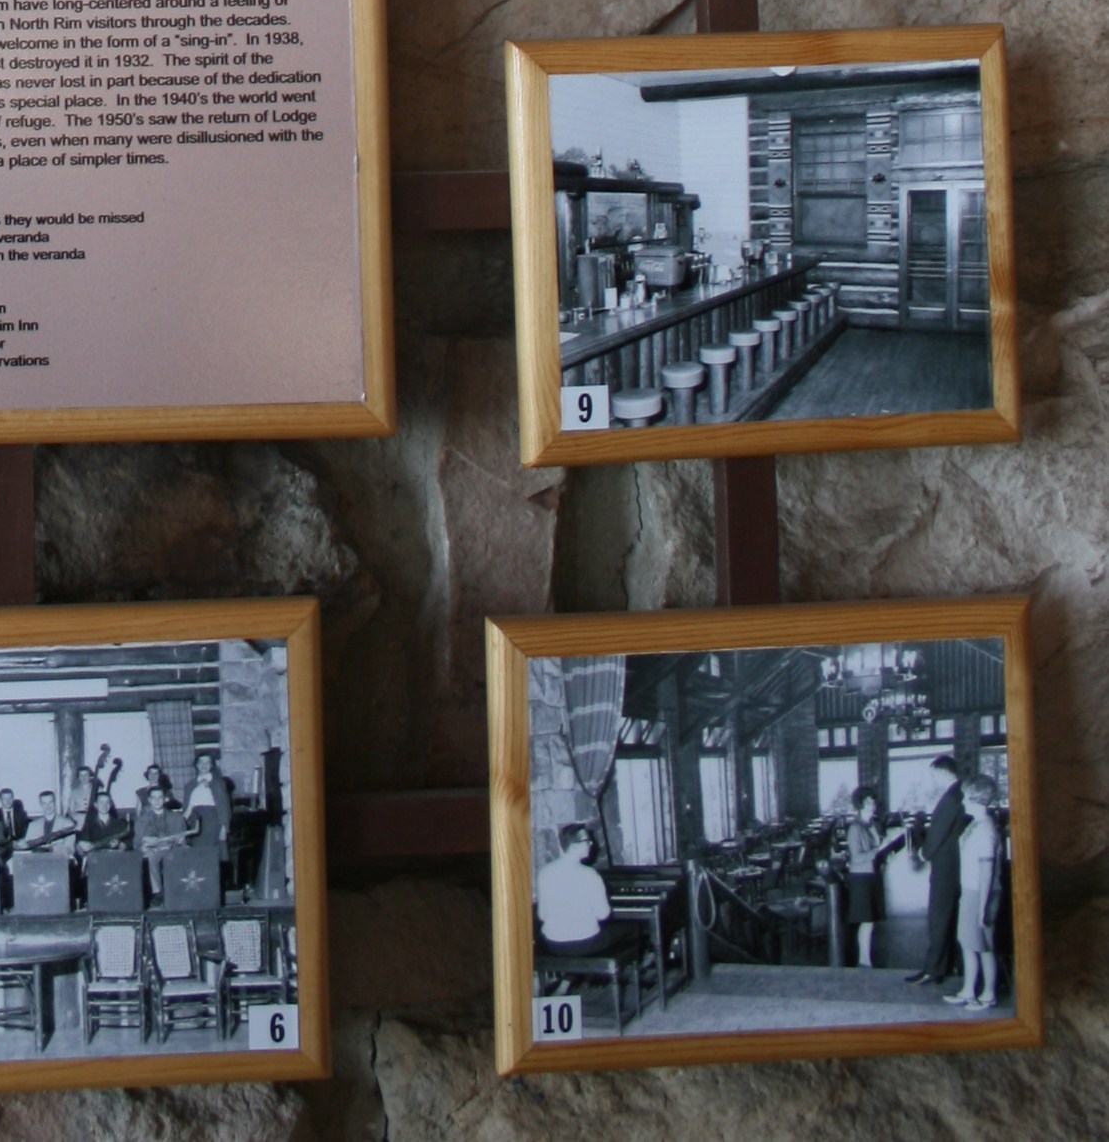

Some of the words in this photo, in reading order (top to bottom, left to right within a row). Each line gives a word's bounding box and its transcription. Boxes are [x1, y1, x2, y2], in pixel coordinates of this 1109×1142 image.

[14, 0, 49, 11] have
[64, 37, 76, 49] in
[80, 37, 103, 49] the
[107, 36, 140, 48] form
[144, 35, 158, 48] of
[162, 38, 171, 48] a
[175, 33, 237, 50] "sing-in".
[247, 33, 260, 46] In
[265, 32, 304, 46] 1938,
[16, 79, 56, 89] never
[61, 76, 86, 88] lost
[90, 75, 102, 88] in
[107, 75, 135, 90] part
[139, 74, 200, 87] because
[205, 73, 219, 86] of
[222, 72, 245, 85] the
[249, 71, 322, 84] dedication
[6, 115, 55, 131] refuge.
[65, 114, 93, 127] The
[98, 113, 145, 126] 1950's
[149, 116, 178, 126] saw
[182, 112, 204, 125] the
[209, 112, 250, 124] return
[255, 110, 269, 123] of
[273, 110, 317, 126] Lodge
[9, 154, 48, 170] place
[52, 153, 67, 167] of
[70, 153, 123, 169] simpler
[127, 152, 169, 165] times.
[5, 215, 32, 229] they
[36, 214, 75, 225] would
[79, 213, 95, 225] be
[99, 212, 145, 224] missed
[19, 320, 39, 332] Inn
[578, 393, 593, 423] 9
[269, 1012, 285, 1043] 6
[543, 1003, 573, 1034] 10
